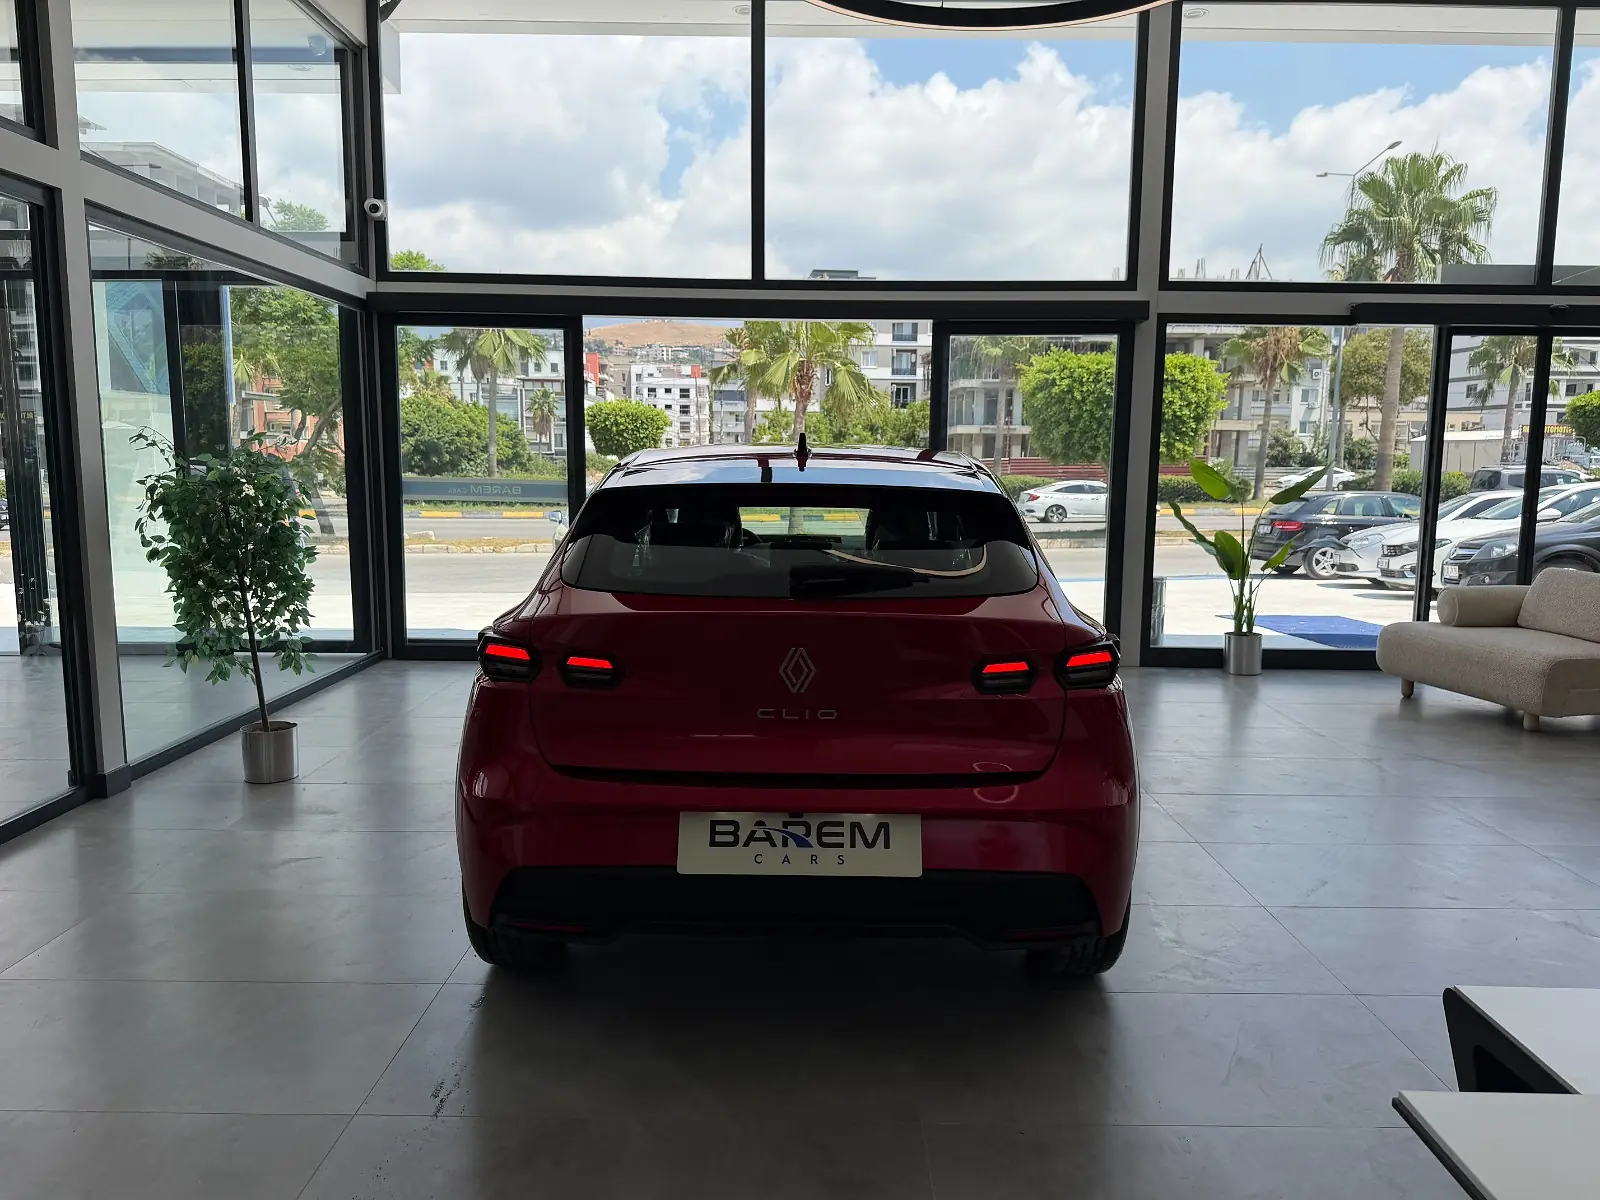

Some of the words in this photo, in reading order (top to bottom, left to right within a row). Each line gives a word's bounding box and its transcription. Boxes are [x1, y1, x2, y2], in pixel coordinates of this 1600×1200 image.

[756, 708, 838, 720] CLIO
[708, 819, 891, 850] BAREM
[754, 853, 845, 865] CARS
